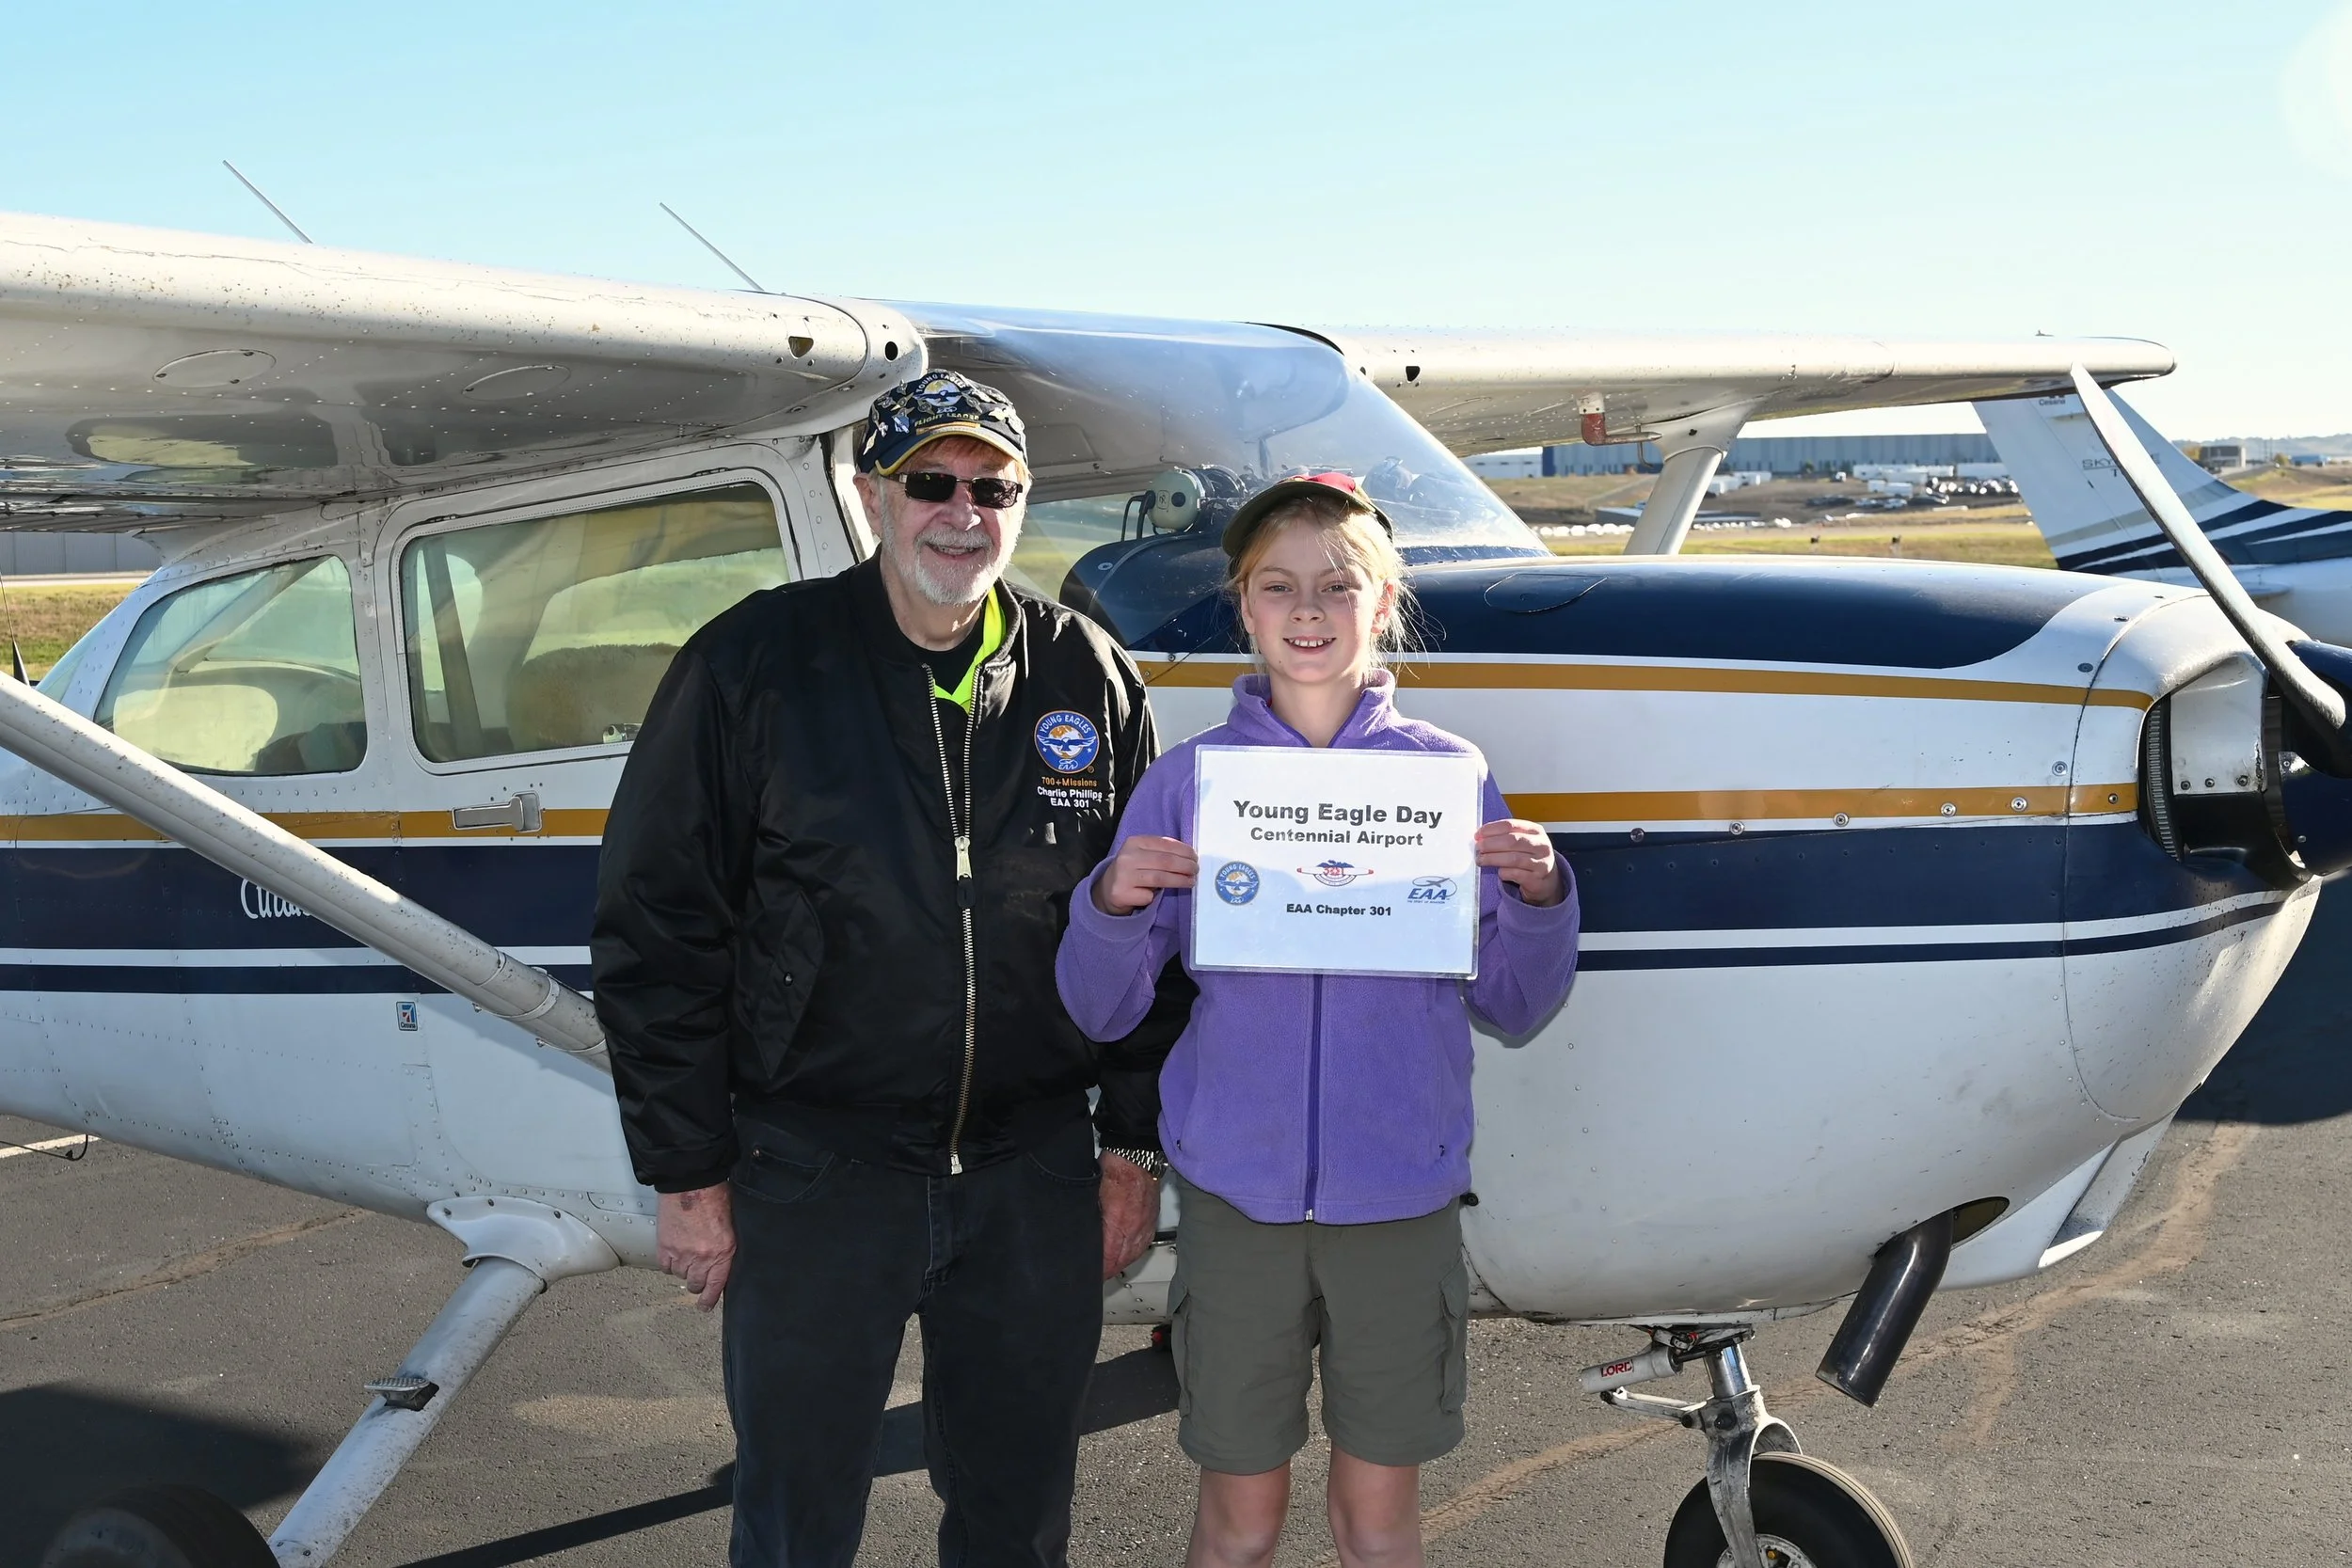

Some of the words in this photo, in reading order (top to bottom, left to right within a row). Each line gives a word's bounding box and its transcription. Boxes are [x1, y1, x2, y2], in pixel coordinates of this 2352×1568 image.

[915, 373, 938, 393] YOUNG
[914, 414, 943, 427] FLIGHT
[1040, 715, 1063, 734] YOUNG
[1064, 715, 1091, 734] EAGLES
[1037, 785, 1067, 798] Charlie
[1069, 788, 1103, 800] Phillips
[1050, 798, 1072, 807] EAA
[1073, 799, 1089, 808] 301
[1233, 800, 1310, 825] Young
[1318, 802, 1388, 827] Eagle
[1396, 805, 1443, 830] Day
[1250, 827, 1351, 844] Centennial
[1357, 831, 1423, 848] Airport
[1219, 863, 1237, 879] YOUNG
[1407, 888, 1447, 900] EAA
[1286, 903, 1312, 913] EAA
[1316, 904, 1367, 917] Chapter
[1370, 906, 1391, 916] 301
[1601, 1360, 1633, 1378] LORD
